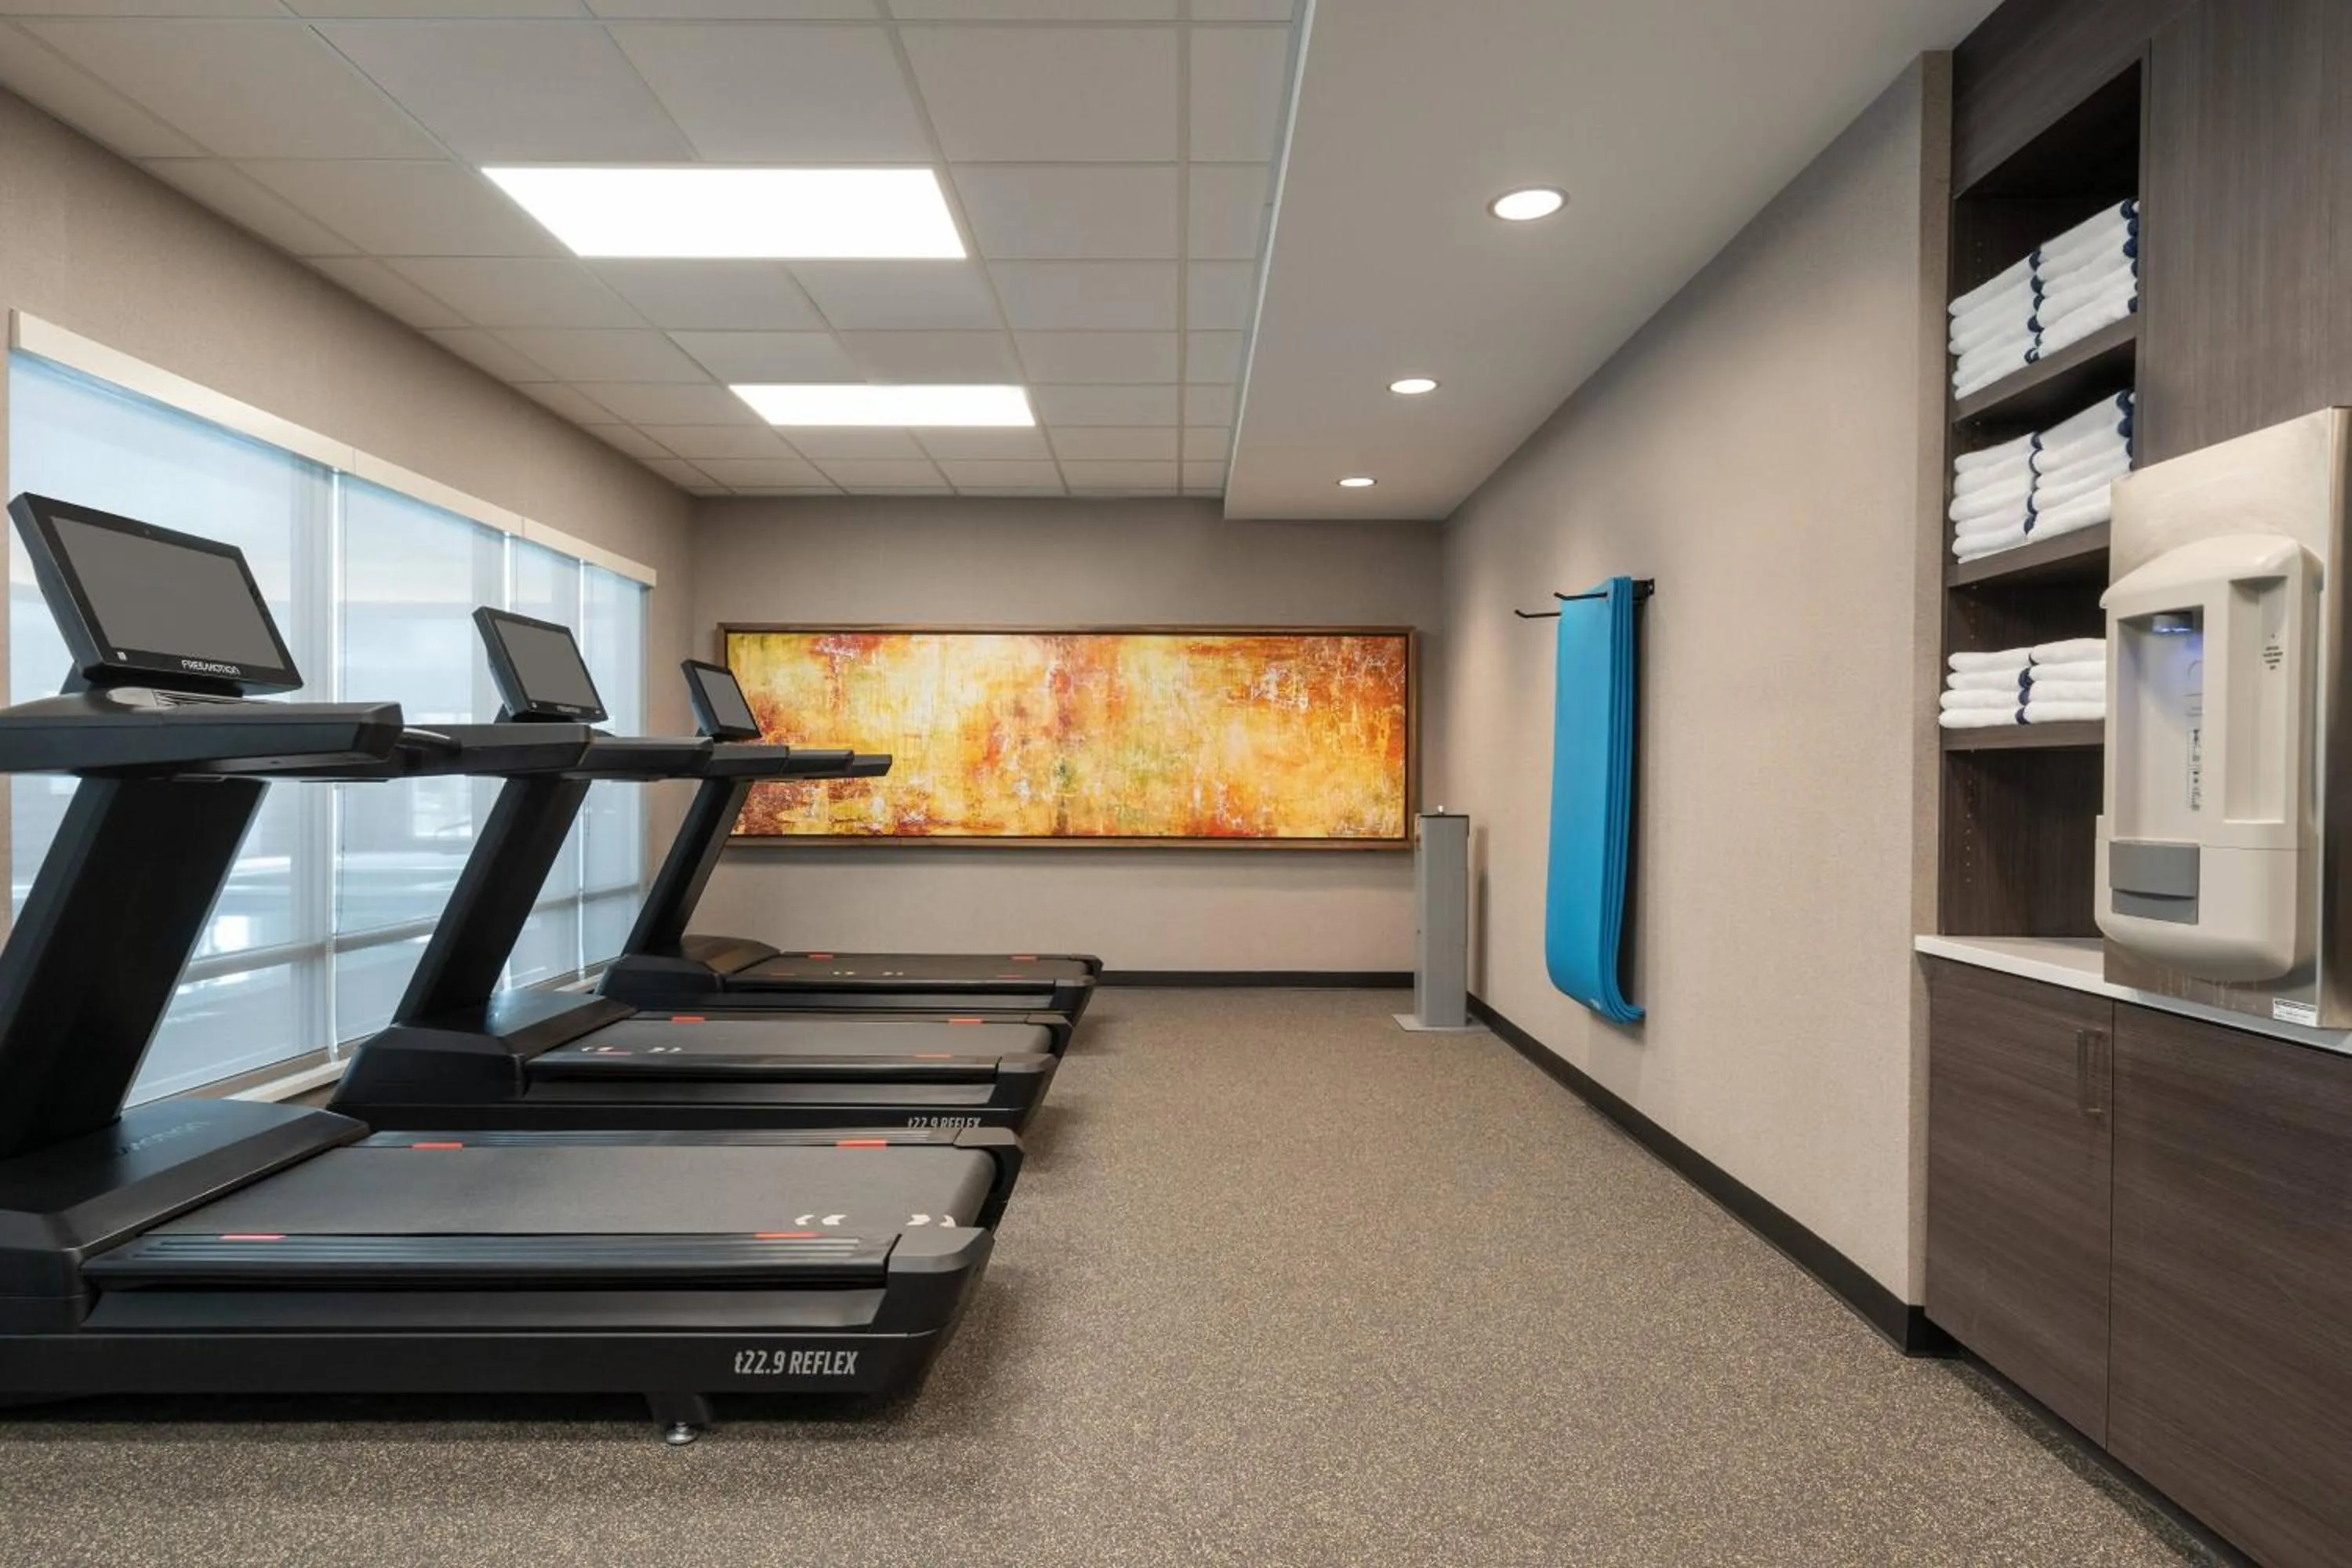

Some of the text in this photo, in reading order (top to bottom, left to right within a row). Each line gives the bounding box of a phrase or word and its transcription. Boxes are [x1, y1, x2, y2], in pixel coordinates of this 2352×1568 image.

[908, 1116, 981, 1128] t229 REFLEX
[735, 1350, 858, 1374] t22.9 REFLEX
